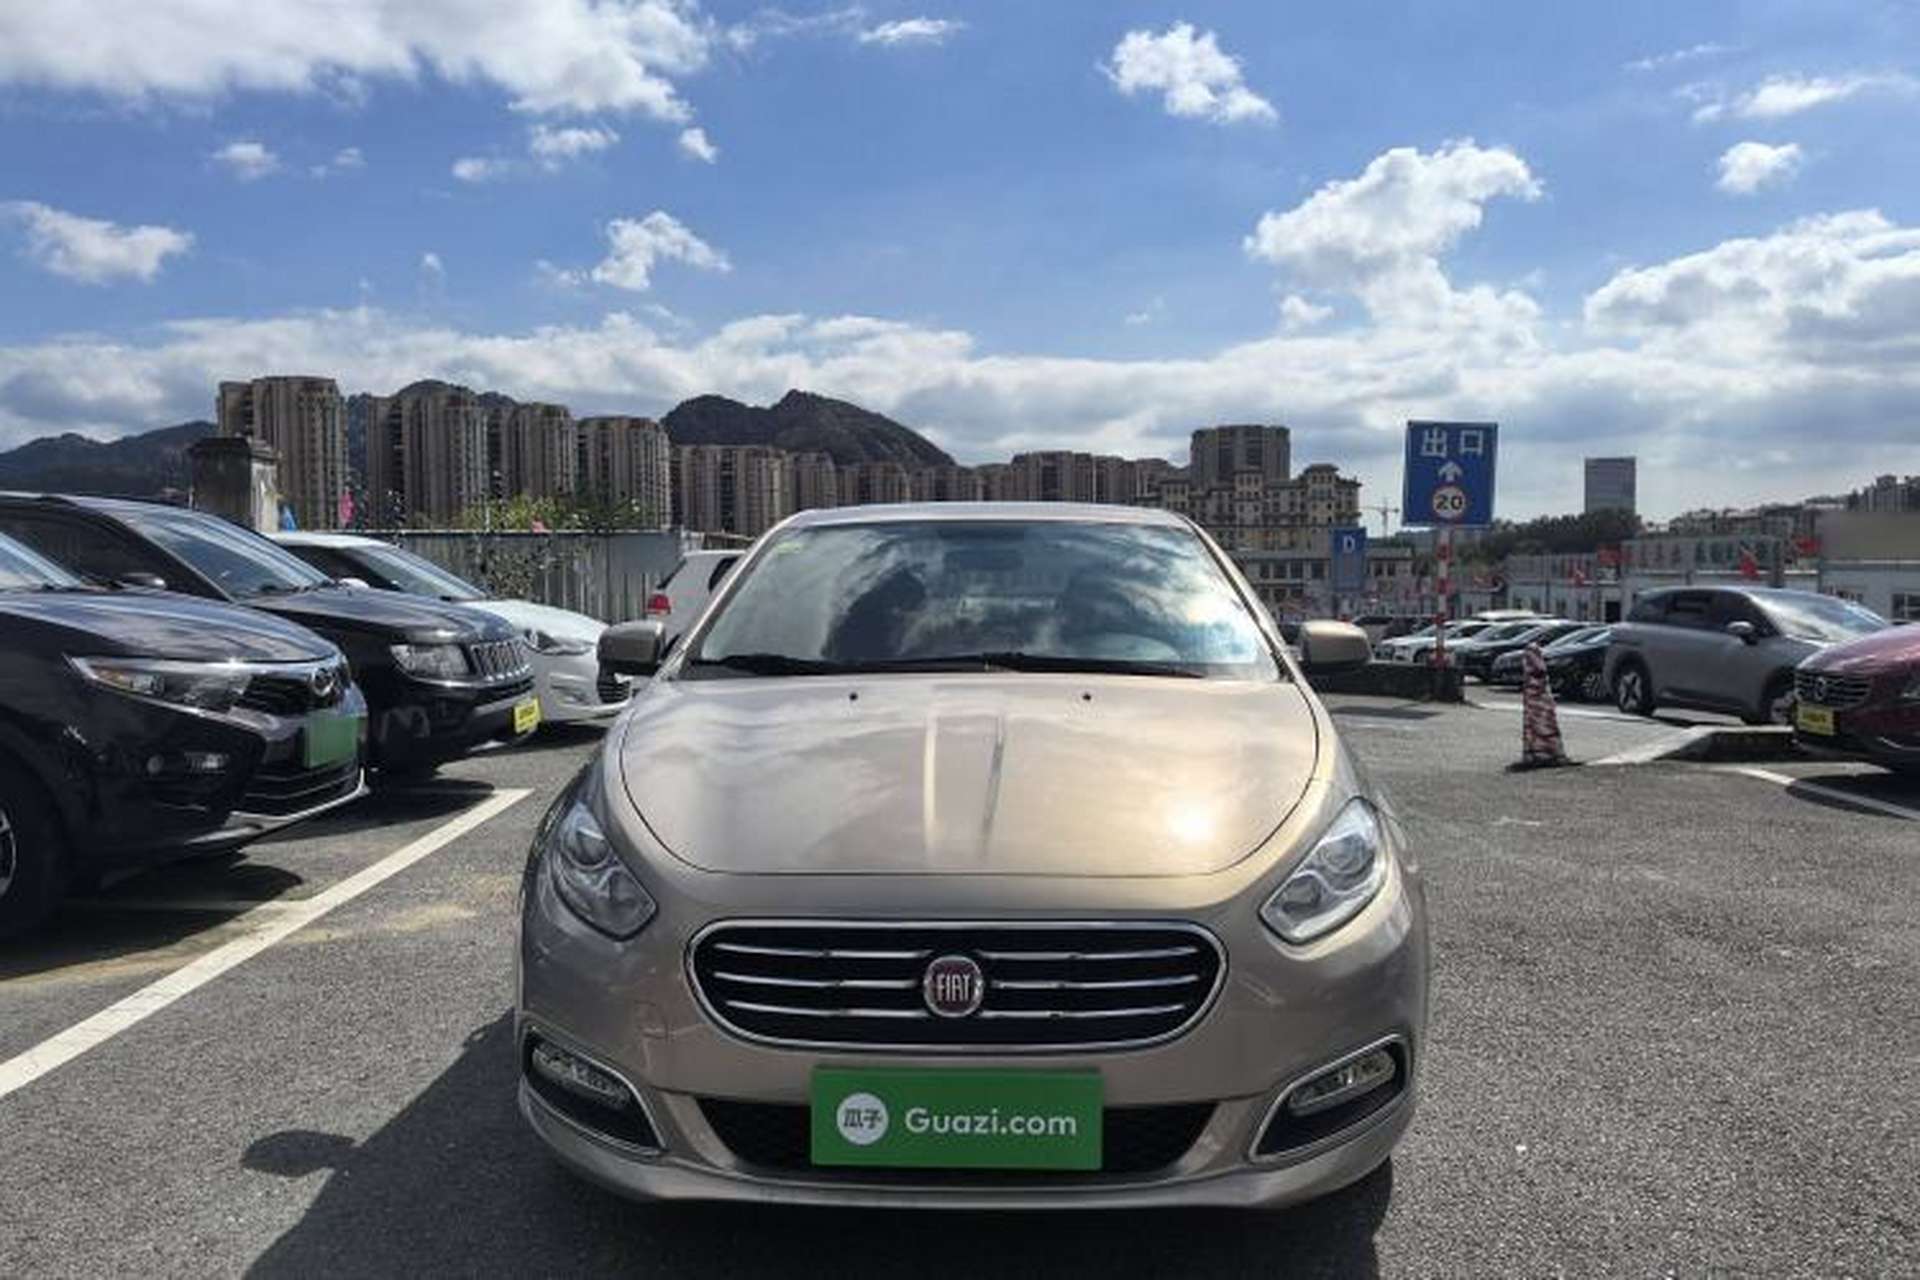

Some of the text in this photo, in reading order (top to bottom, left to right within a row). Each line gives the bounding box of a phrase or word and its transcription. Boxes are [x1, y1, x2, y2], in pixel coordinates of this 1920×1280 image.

[1420, 426, 1484, 458] 出口
[1435, 494, 1463, 511] 20
[1343, 535, 1356, 554] D
[936, 973, 971, 1002] FIAT
[843, 1108, 883, 1130] 瓜子
[904, 1107, 1078, 1136] Guazi.com
